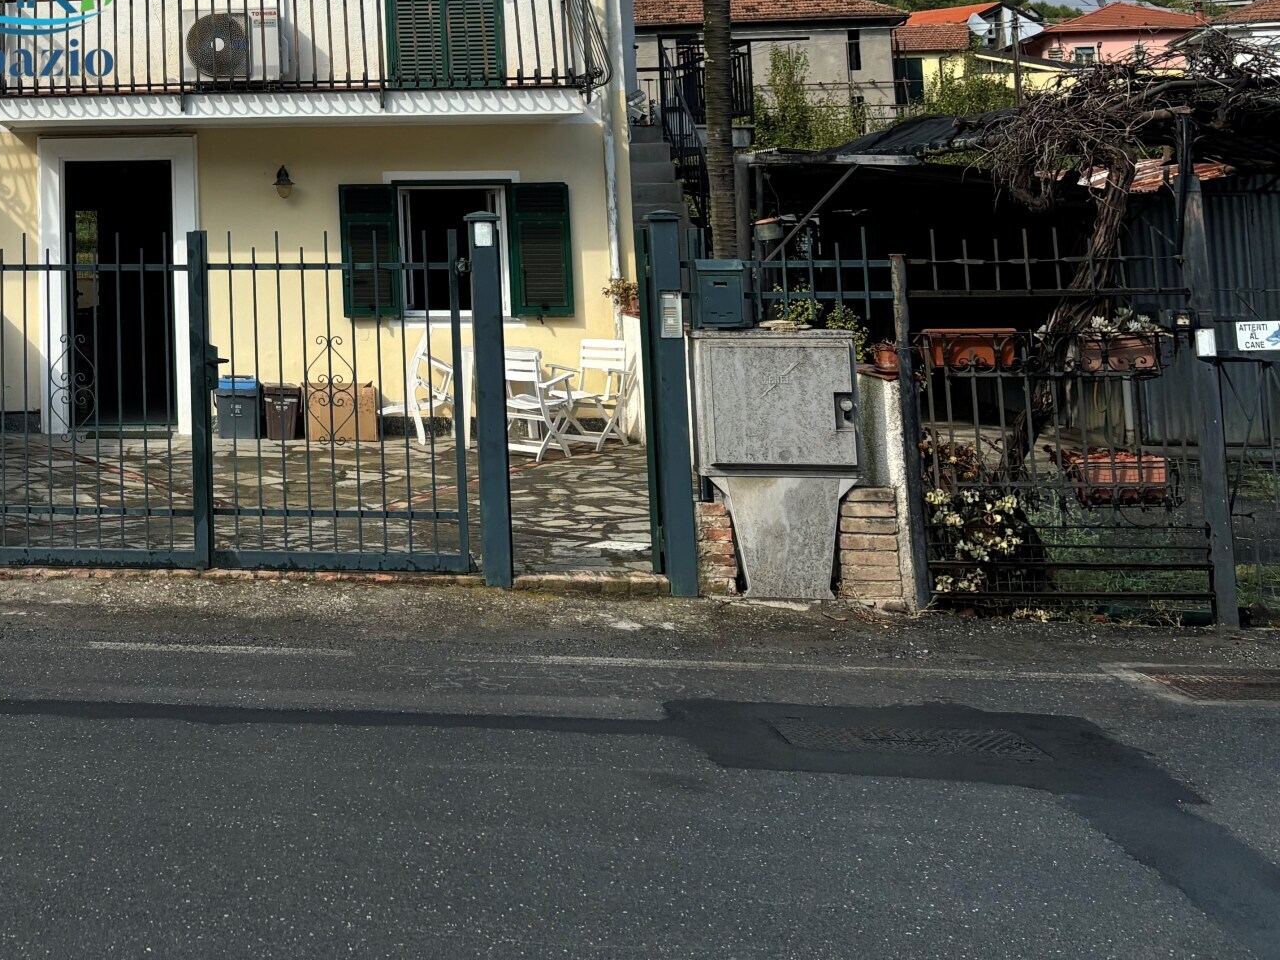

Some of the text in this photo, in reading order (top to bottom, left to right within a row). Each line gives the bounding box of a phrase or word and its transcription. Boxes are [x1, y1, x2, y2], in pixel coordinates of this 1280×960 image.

[1239, 323, 1268, 331] ATTENTI
[1250, 331, 1260, 340] AL
[1245, 341, 1266, 349] CANE
